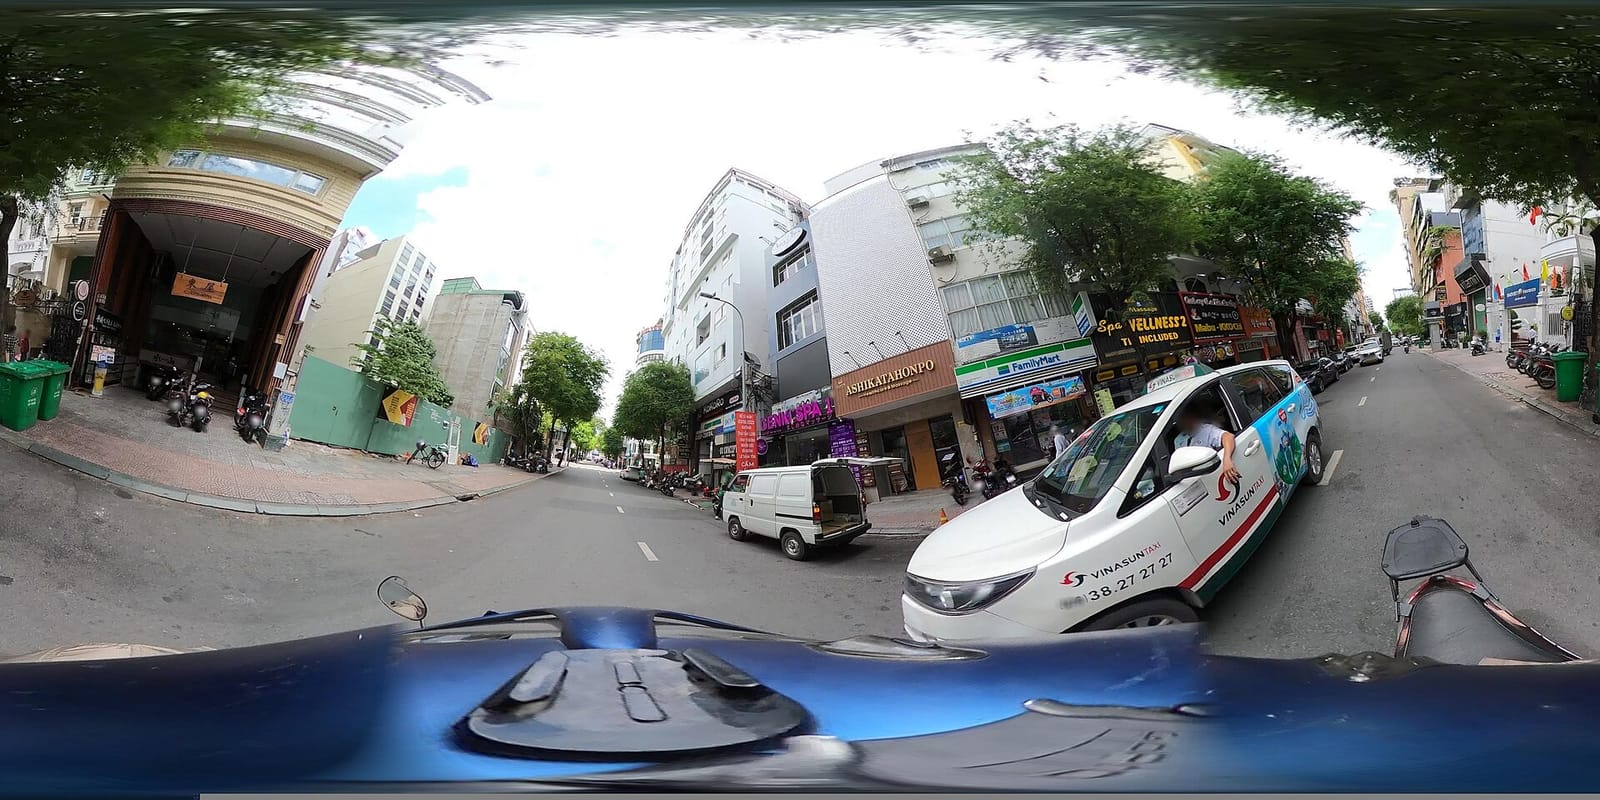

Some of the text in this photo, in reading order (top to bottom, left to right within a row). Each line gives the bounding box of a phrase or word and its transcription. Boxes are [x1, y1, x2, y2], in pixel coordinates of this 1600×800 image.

[1097, 320, 1122, 336] Spa
[1121, 337, 1132, 346] TI
[1139, 332, 1179, 344] INCLUDED
[1012, 355, 1060, 371] FamilyMart
[846, 360, 934, 396] ASHIKATAHONPO
[761, 409, 793, 431] GENKI
[795, 401, 822, 421] SPA
[825, 397, 833, 416] 1
[1139, 563, 1155, 580] 27
[1158, 553, 1173, 568] 27
